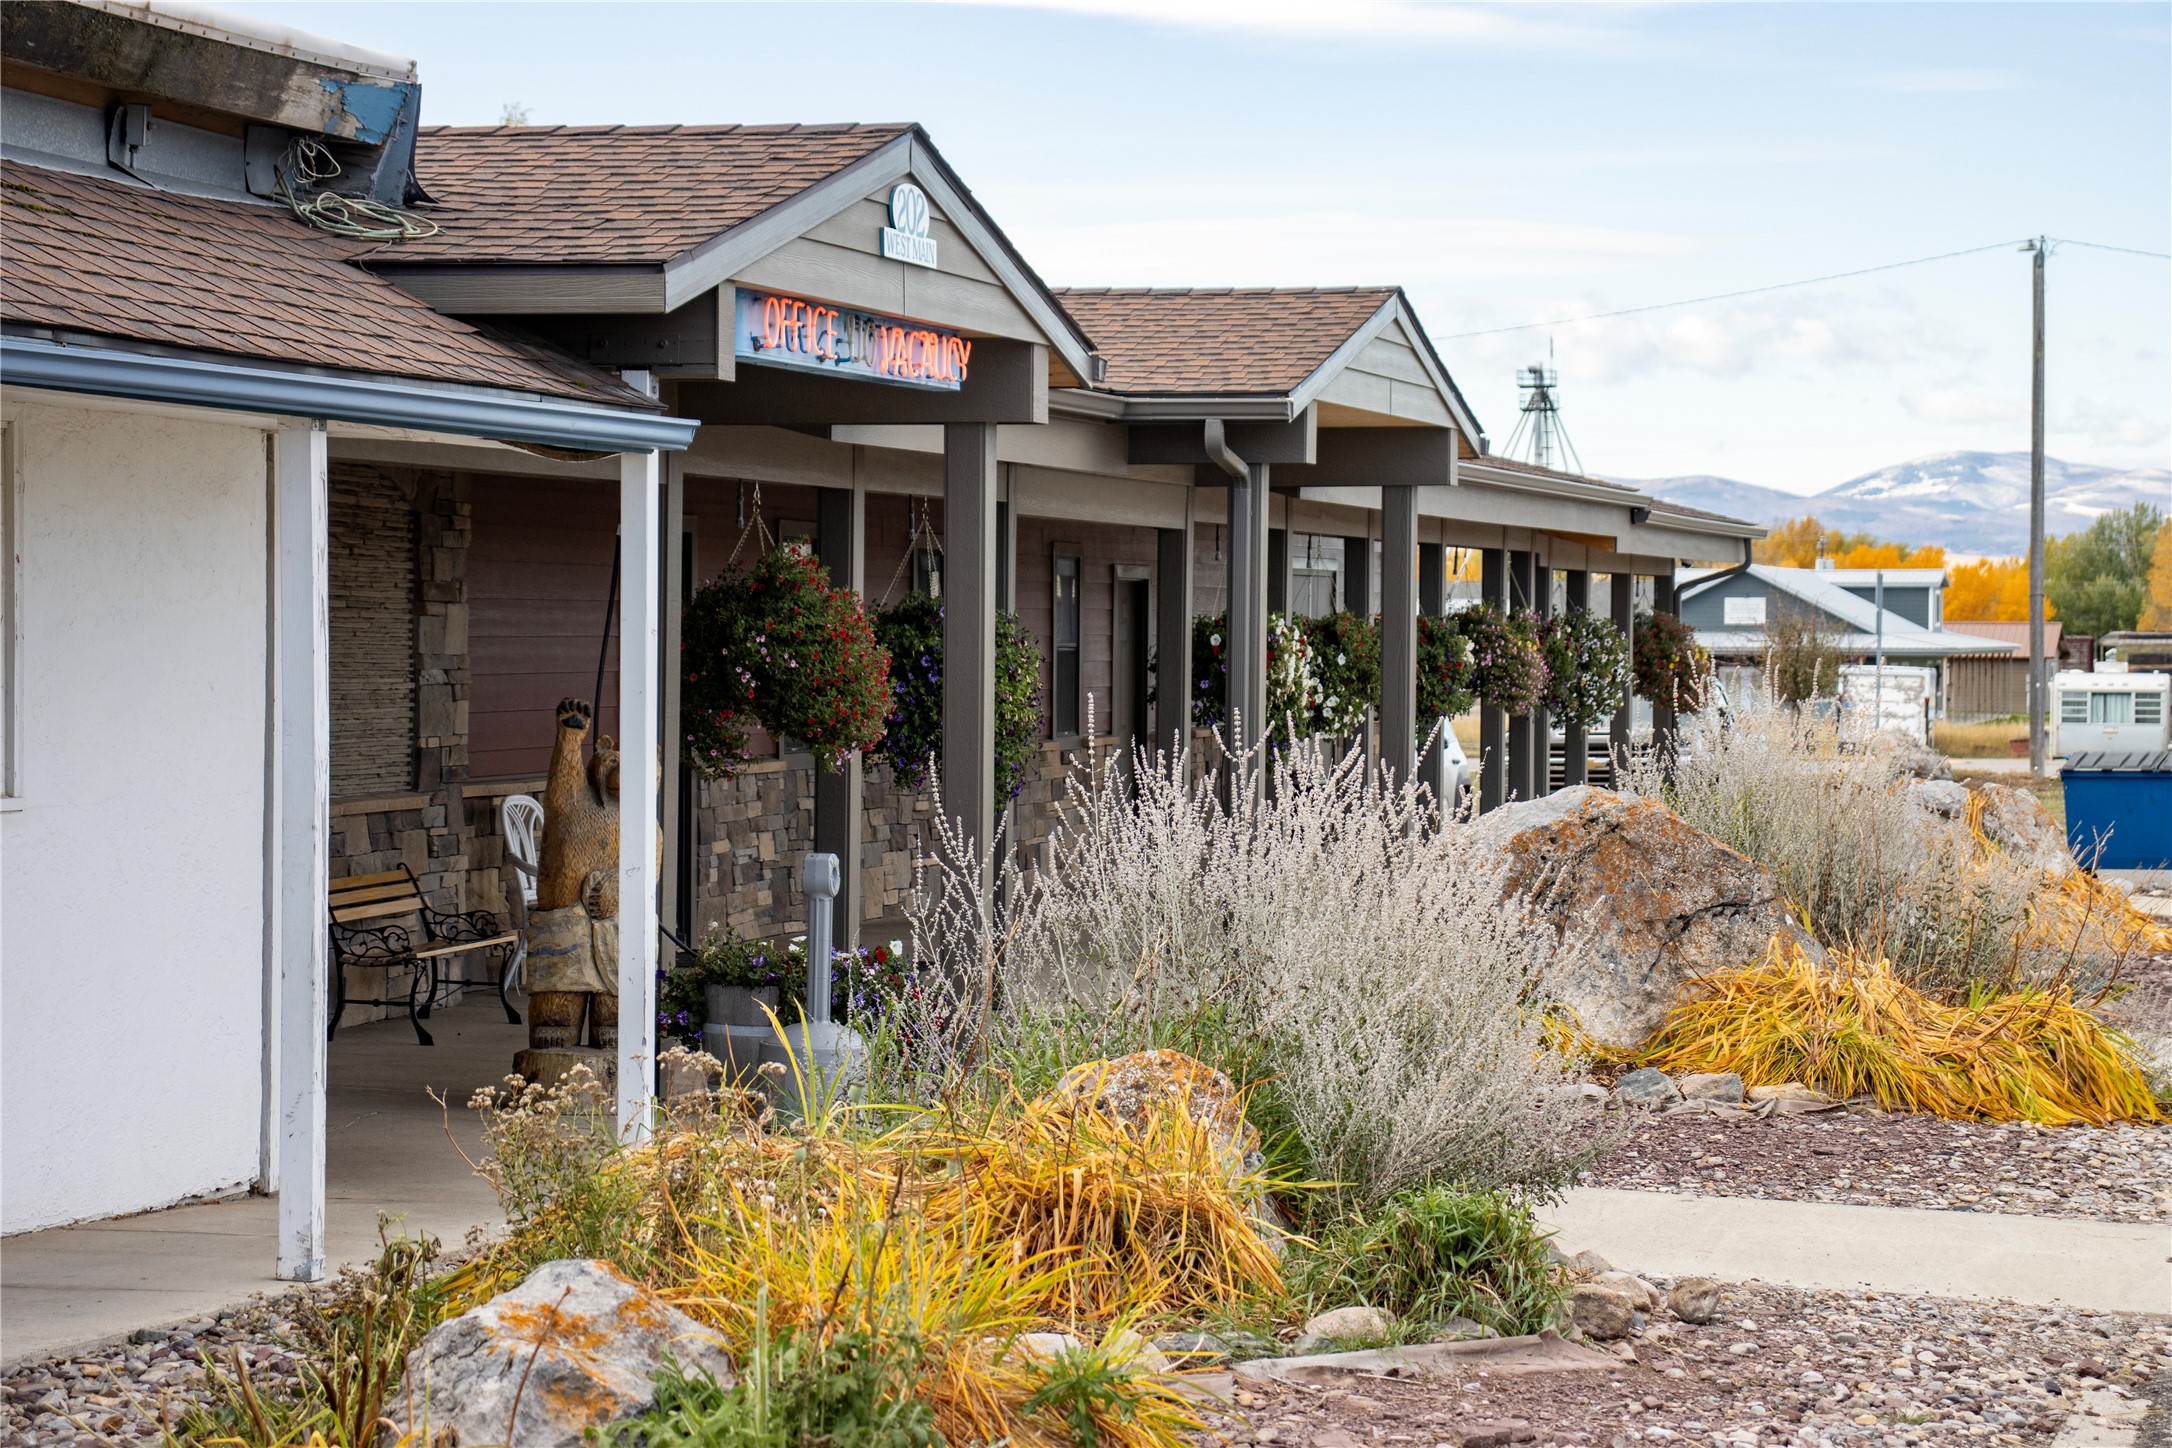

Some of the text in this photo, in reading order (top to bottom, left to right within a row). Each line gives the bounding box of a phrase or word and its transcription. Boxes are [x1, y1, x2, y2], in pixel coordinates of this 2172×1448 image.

[897, 187, 925, 239] 202
[886, 231, 935, 265] WEST MAIN
[763, 295, 972, 382] OFFICE NO VACANCY
